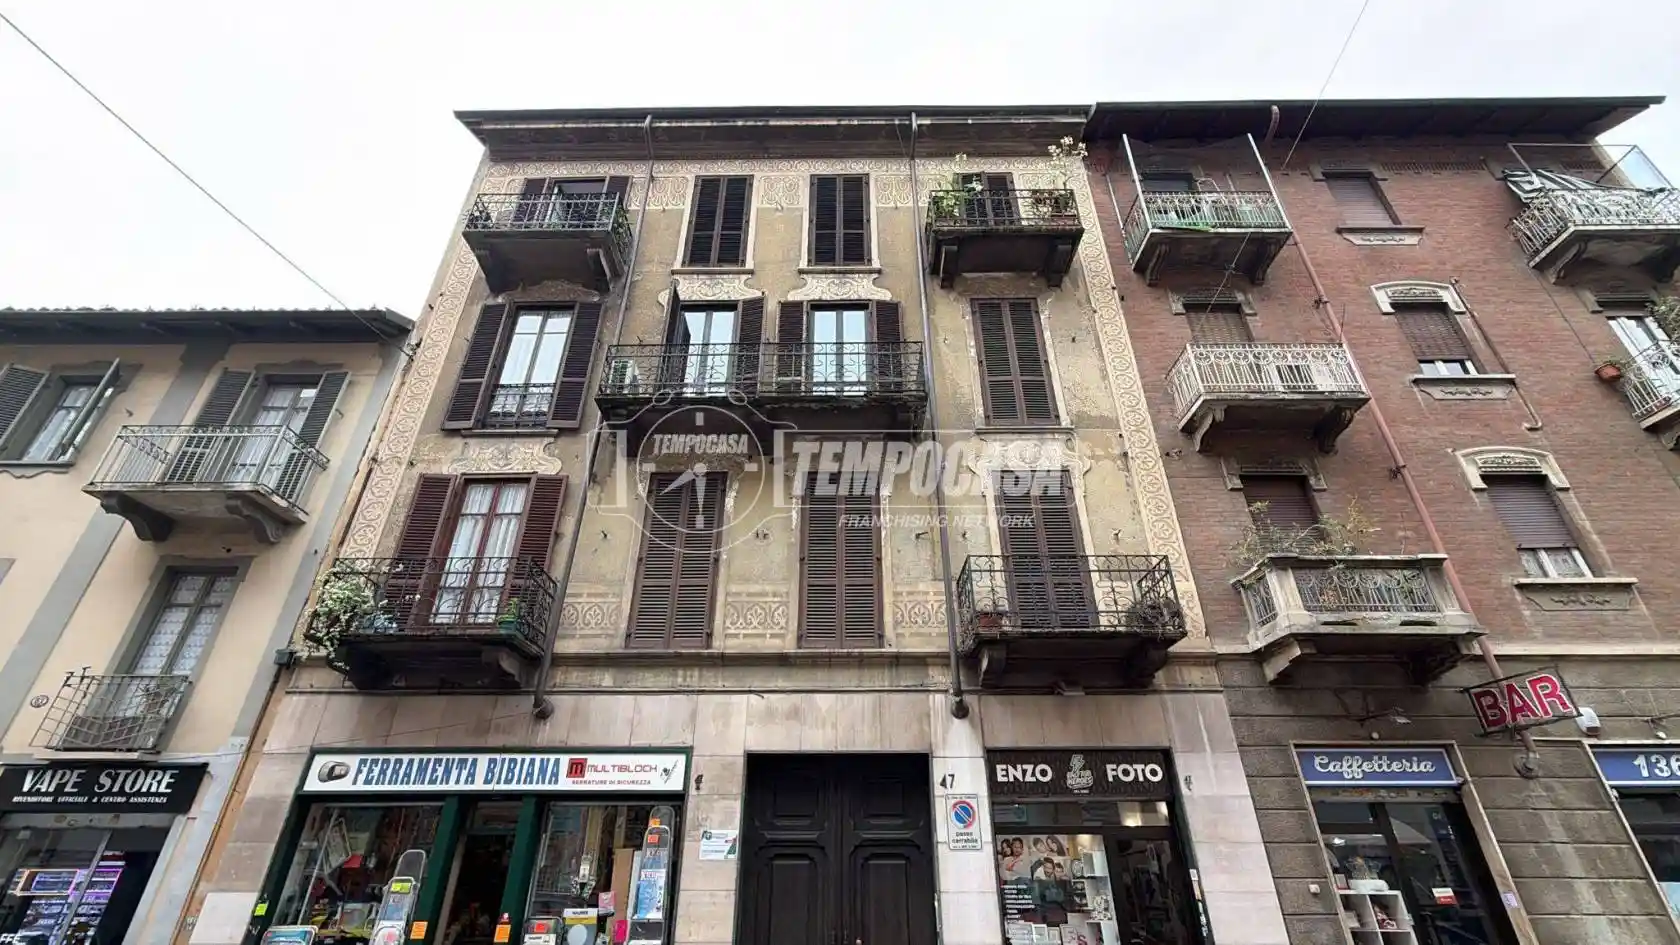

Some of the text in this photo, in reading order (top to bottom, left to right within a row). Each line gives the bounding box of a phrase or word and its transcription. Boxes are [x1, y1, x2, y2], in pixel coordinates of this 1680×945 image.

[1472, 674, 1577, 728] BAR
[352, 758, 561, 786] FERRAMENTA BIBIANA
[995, 764, 1053, 782] ENZO
[1105, 763, 1164, 782] FOTO
[1314, 755, 1436, 779] Caffetteria
[21, 769, 180, 793] VAPE STORE
[940, 774, 955, 788] 47
